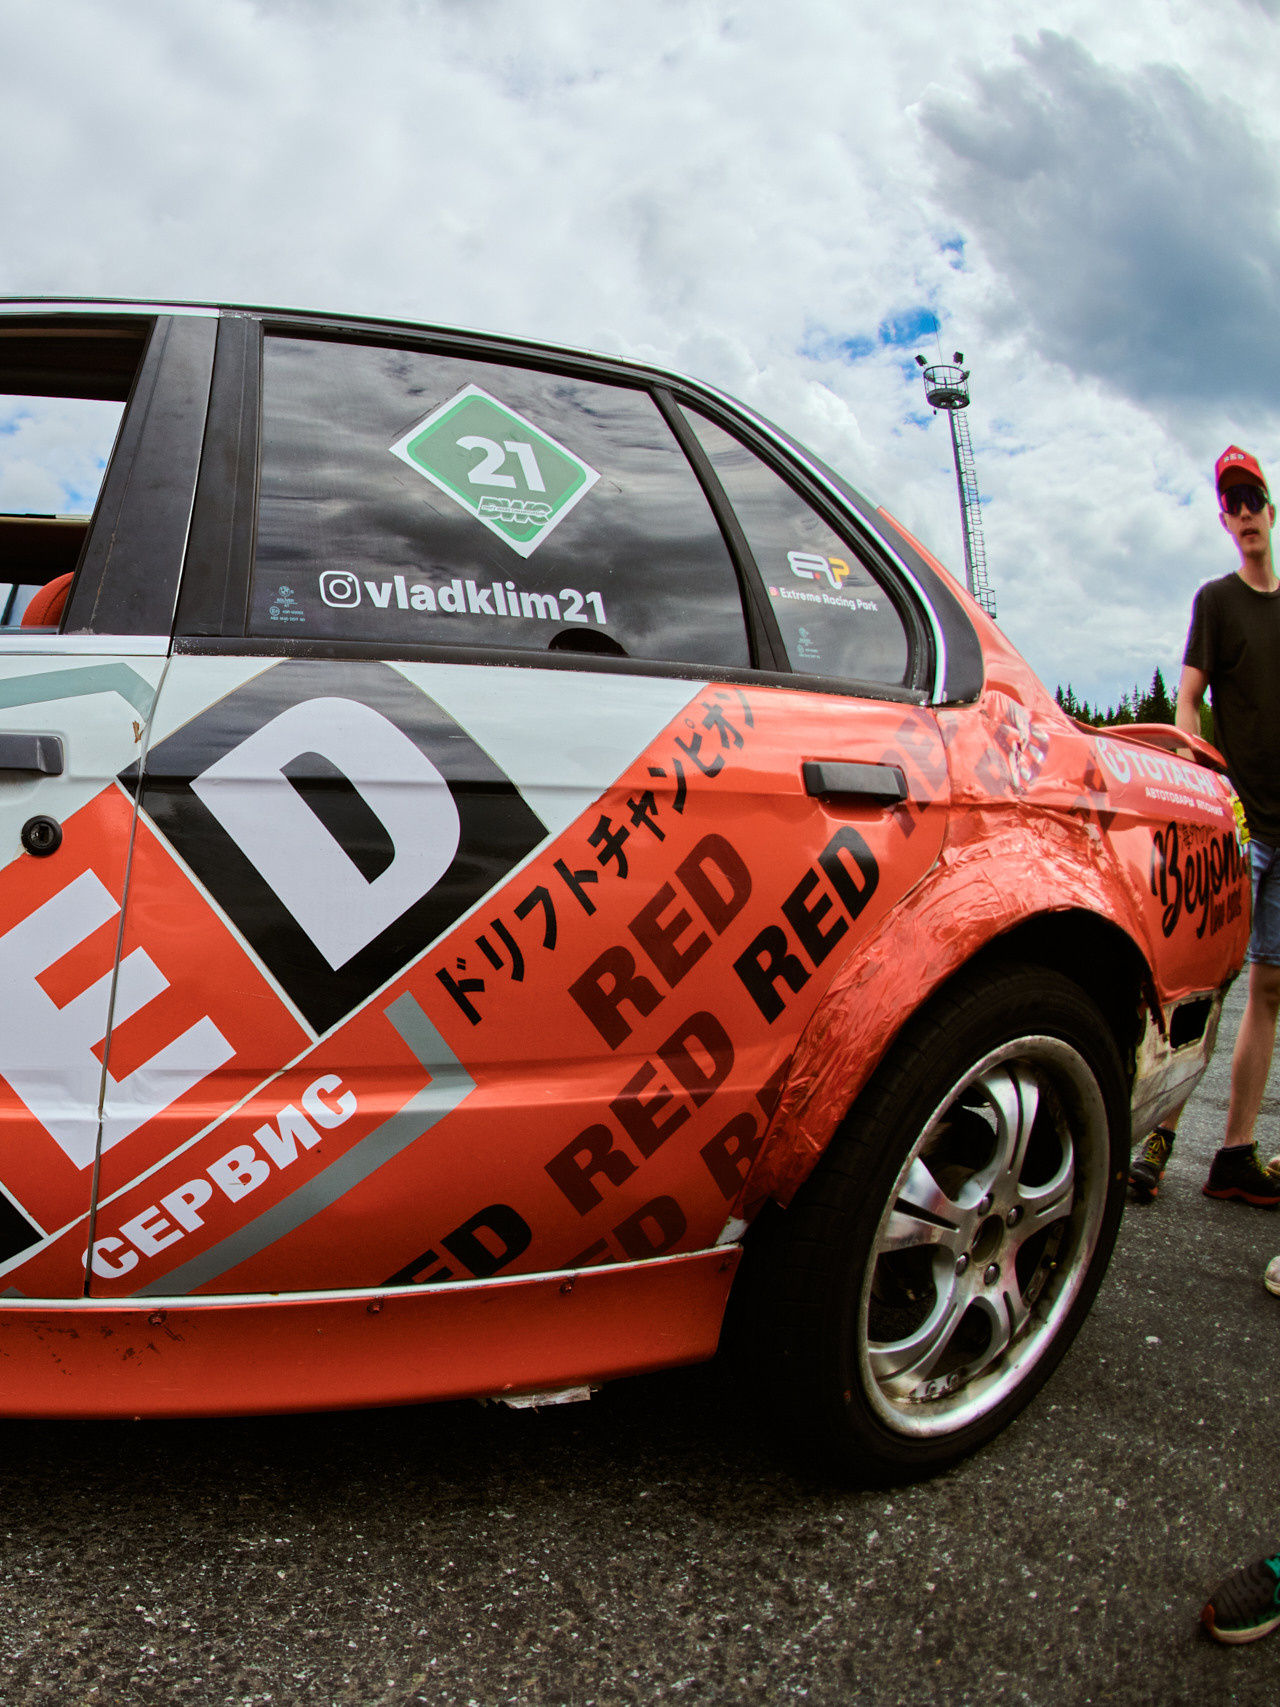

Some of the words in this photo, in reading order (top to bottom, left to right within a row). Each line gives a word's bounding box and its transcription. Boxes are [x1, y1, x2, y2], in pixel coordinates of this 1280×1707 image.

[456, 436, 546, 492] 21
[364, 575, 607, 625] vladklim21
[779, 587, 821, 603] Extreme
[822, 593, 856, 611] Racing
[856, 599, 878, 612] Park
[1122, 749, 1217, 797] TOTACHI
[567, 834, 752, 1051] RED
[733, 826, 880, 1025] RED
[80, 1074, 358, 1279] СЕРВИС
[544, 1011, 735, 1216] RED
